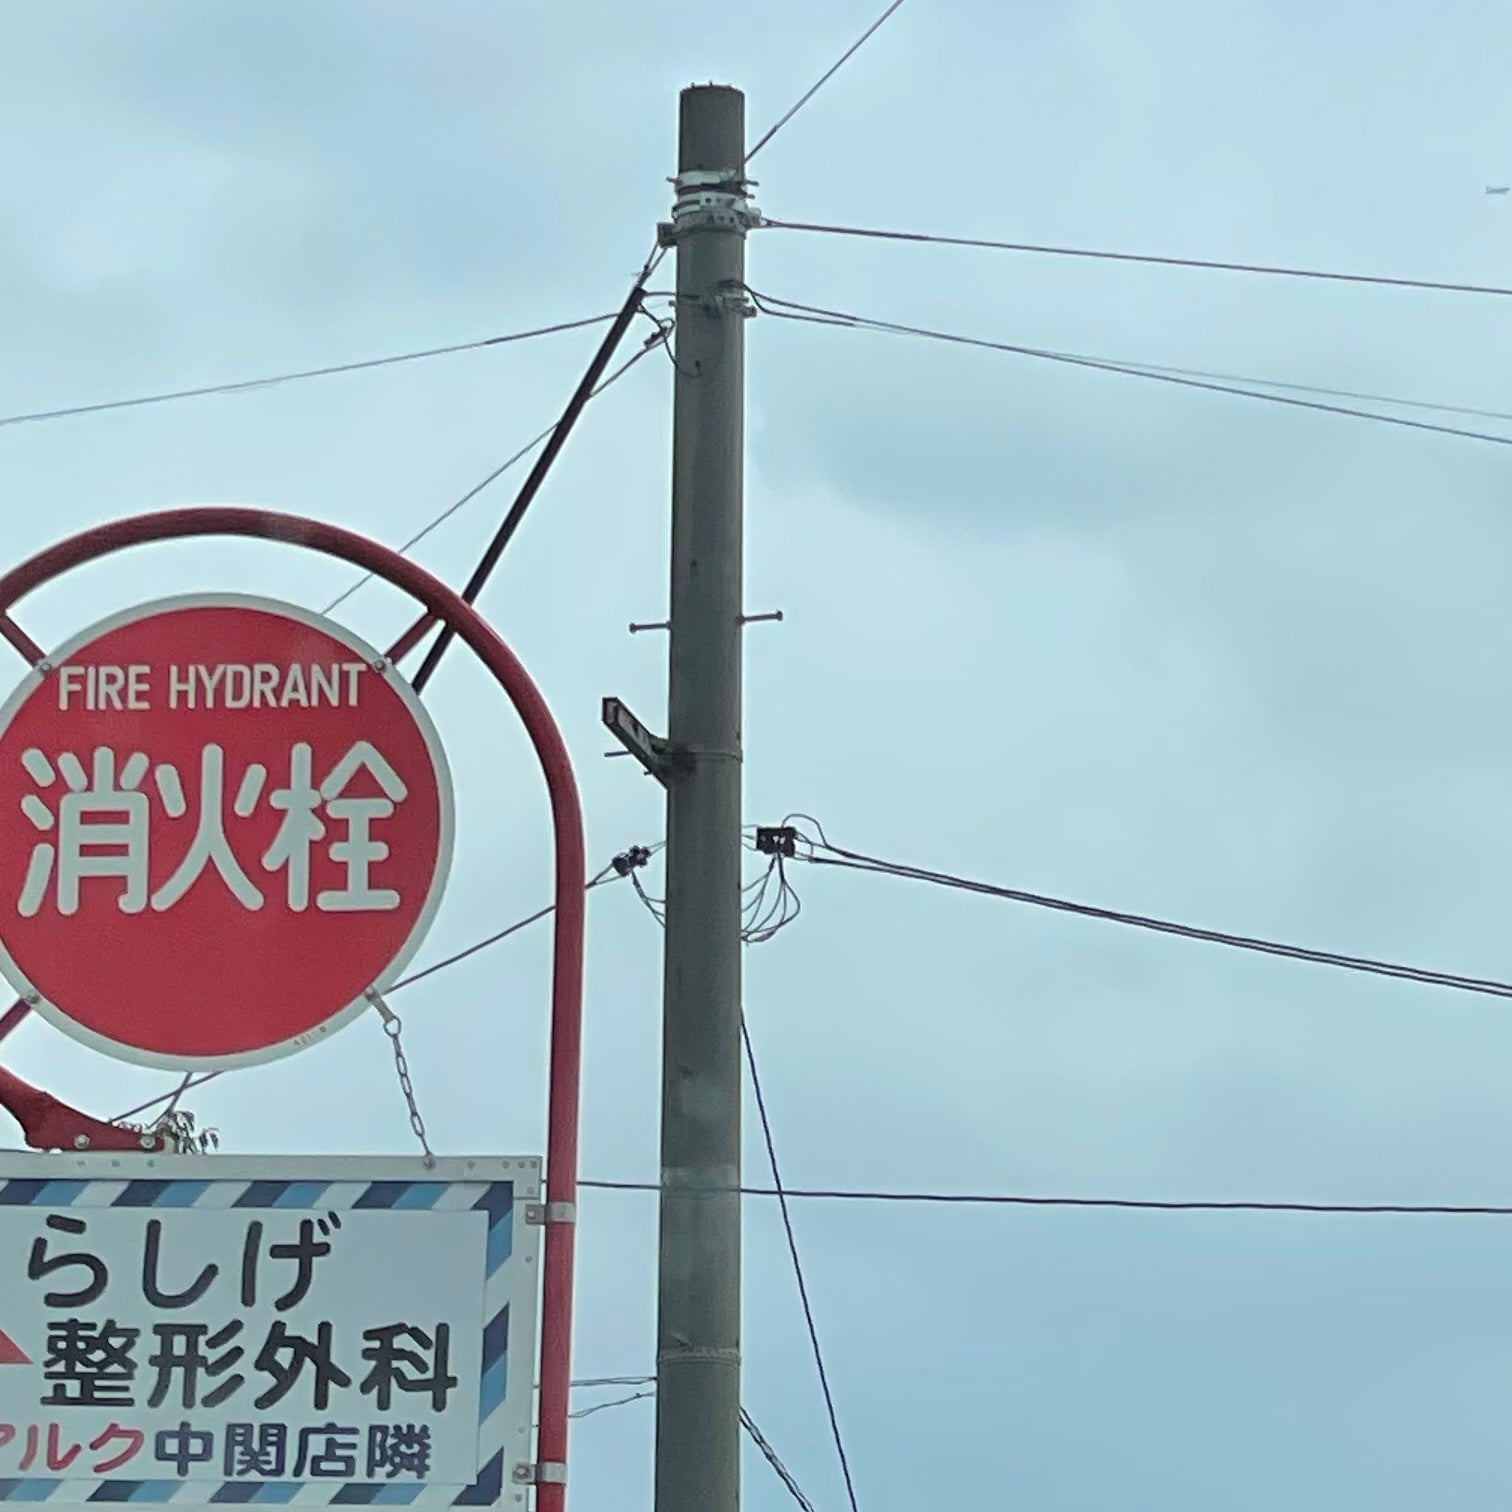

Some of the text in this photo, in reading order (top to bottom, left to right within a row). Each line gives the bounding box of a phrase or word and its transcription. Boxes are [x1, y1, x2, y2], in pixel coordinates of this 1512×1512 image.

[58, 662, 367, 711] FIRE HYDRANT
[18, 741, 408, 917] 消火栓
[27, 1210, 342, 1312] らしげ
[41, 1318, 458, 1411] 整形外科
